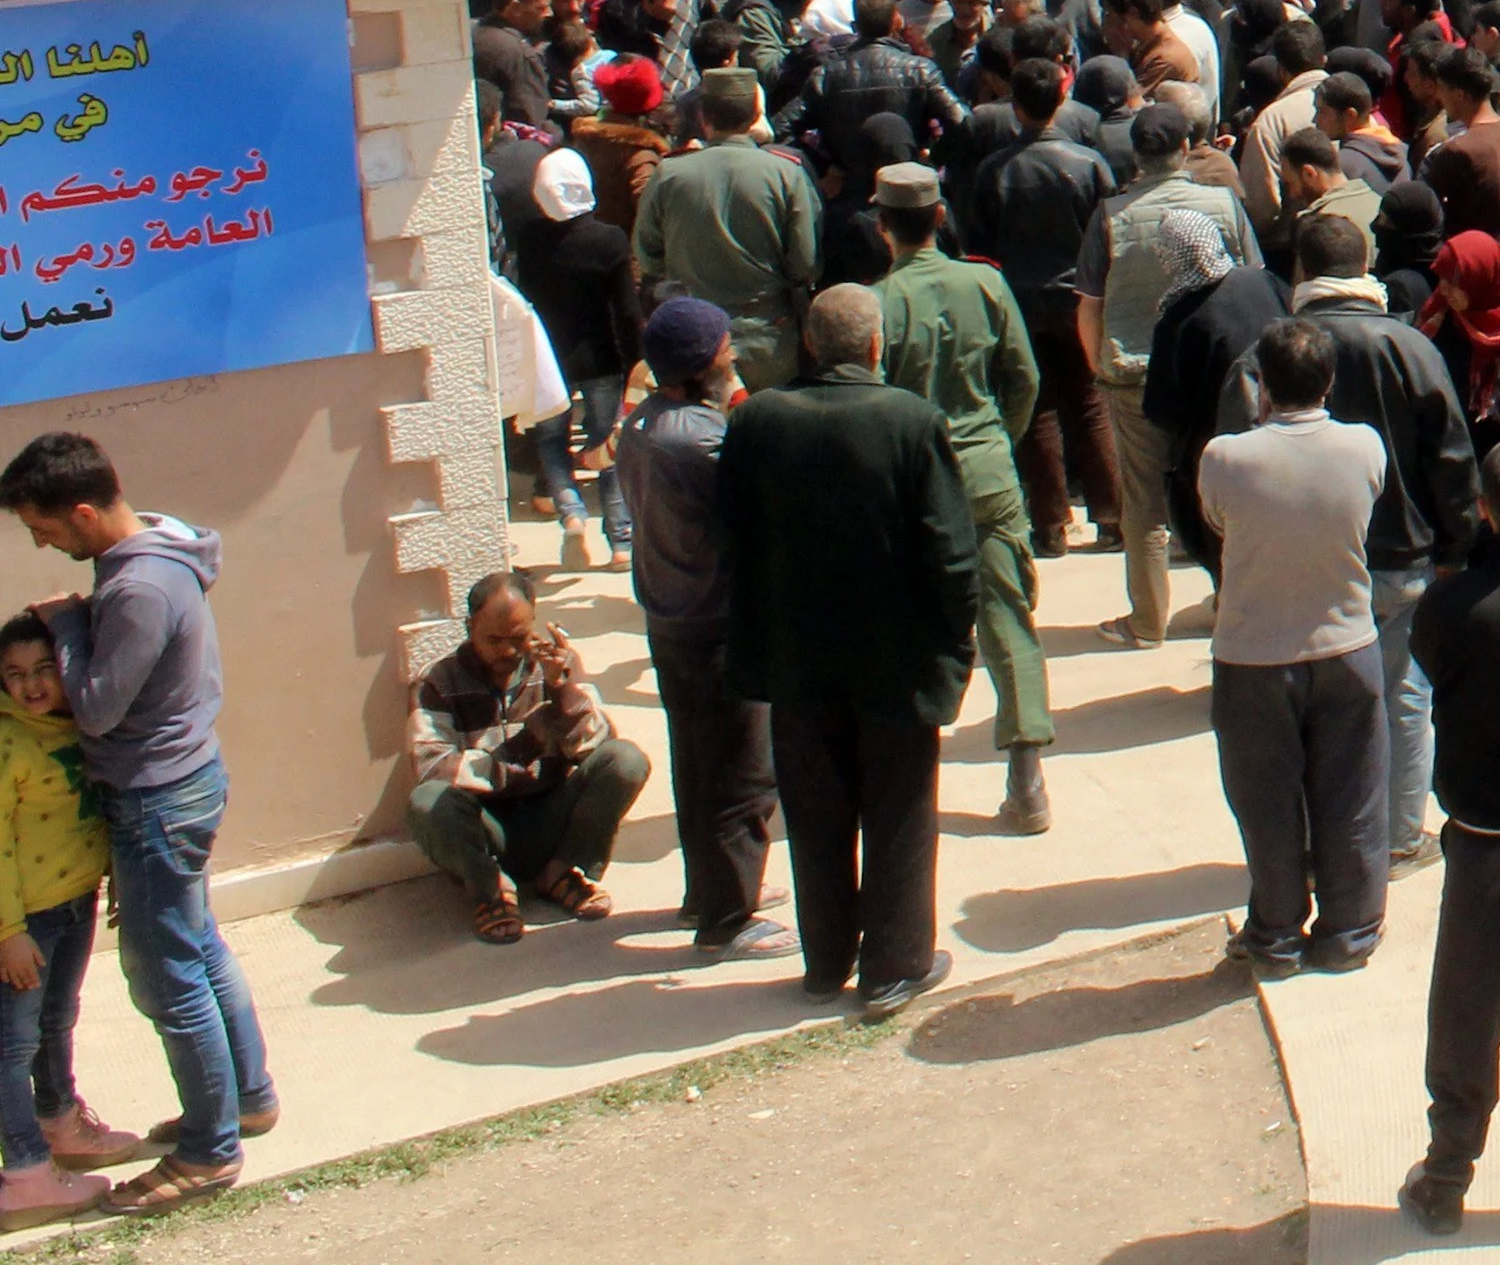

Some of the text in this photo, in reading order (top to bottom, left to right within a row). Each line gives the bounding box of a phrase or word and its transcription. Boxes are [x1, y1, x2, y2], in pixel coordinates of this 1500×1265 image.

[45, 30, 150, 79] أهلنا
[54, 92, 109, 143] في
[20, 168, 157, 223] منكم
[162, 148, 269, 204] نرجو
[144, 206, 275, 253] العامة
[34, 235, 137, 283] ورمي
[0, 286, 114, 342] نعمل
